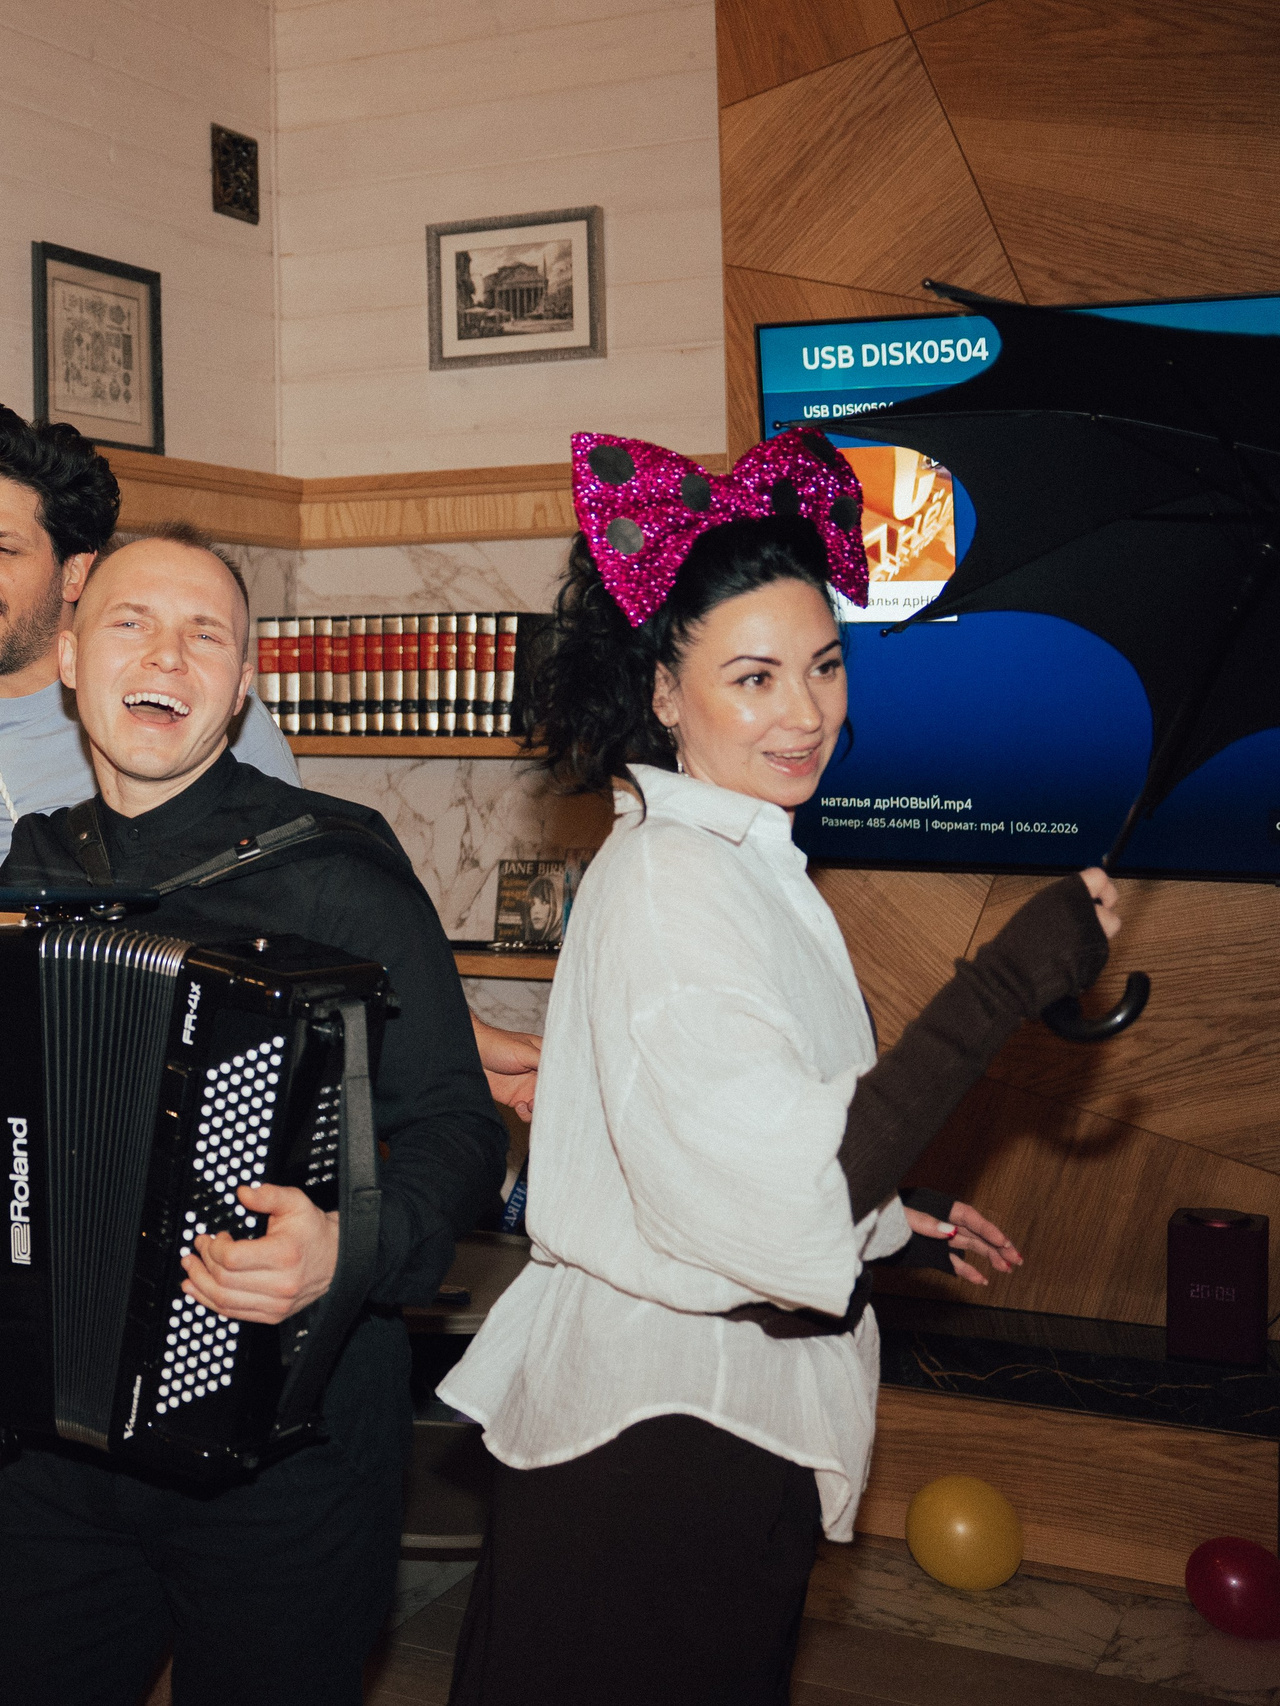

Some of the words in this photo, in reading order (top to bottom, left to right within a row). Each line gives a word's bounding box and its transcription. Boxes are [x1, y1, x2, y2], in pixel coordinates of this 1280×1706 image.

[802, 345, 854, 370] USB
[862, 337, 989, 367] DISK0504
[804, 404, 829, 419] USB
[821, 796, 871, 808] наталья
[873, 795, 972, 813] дрНОВЫЙ.mp4
[821, 816, 864, 830] Размер:
[866, 817, 921, 830] 485.46MB
[932, 819, 977, 833] Формат:
[980, 821, 1005, 834] mp4
[1015, 821, 1079, 834] 06.02.2026
[502, 862, 534, 875] JANE
[7, 1117, 30, 1223] Roland
